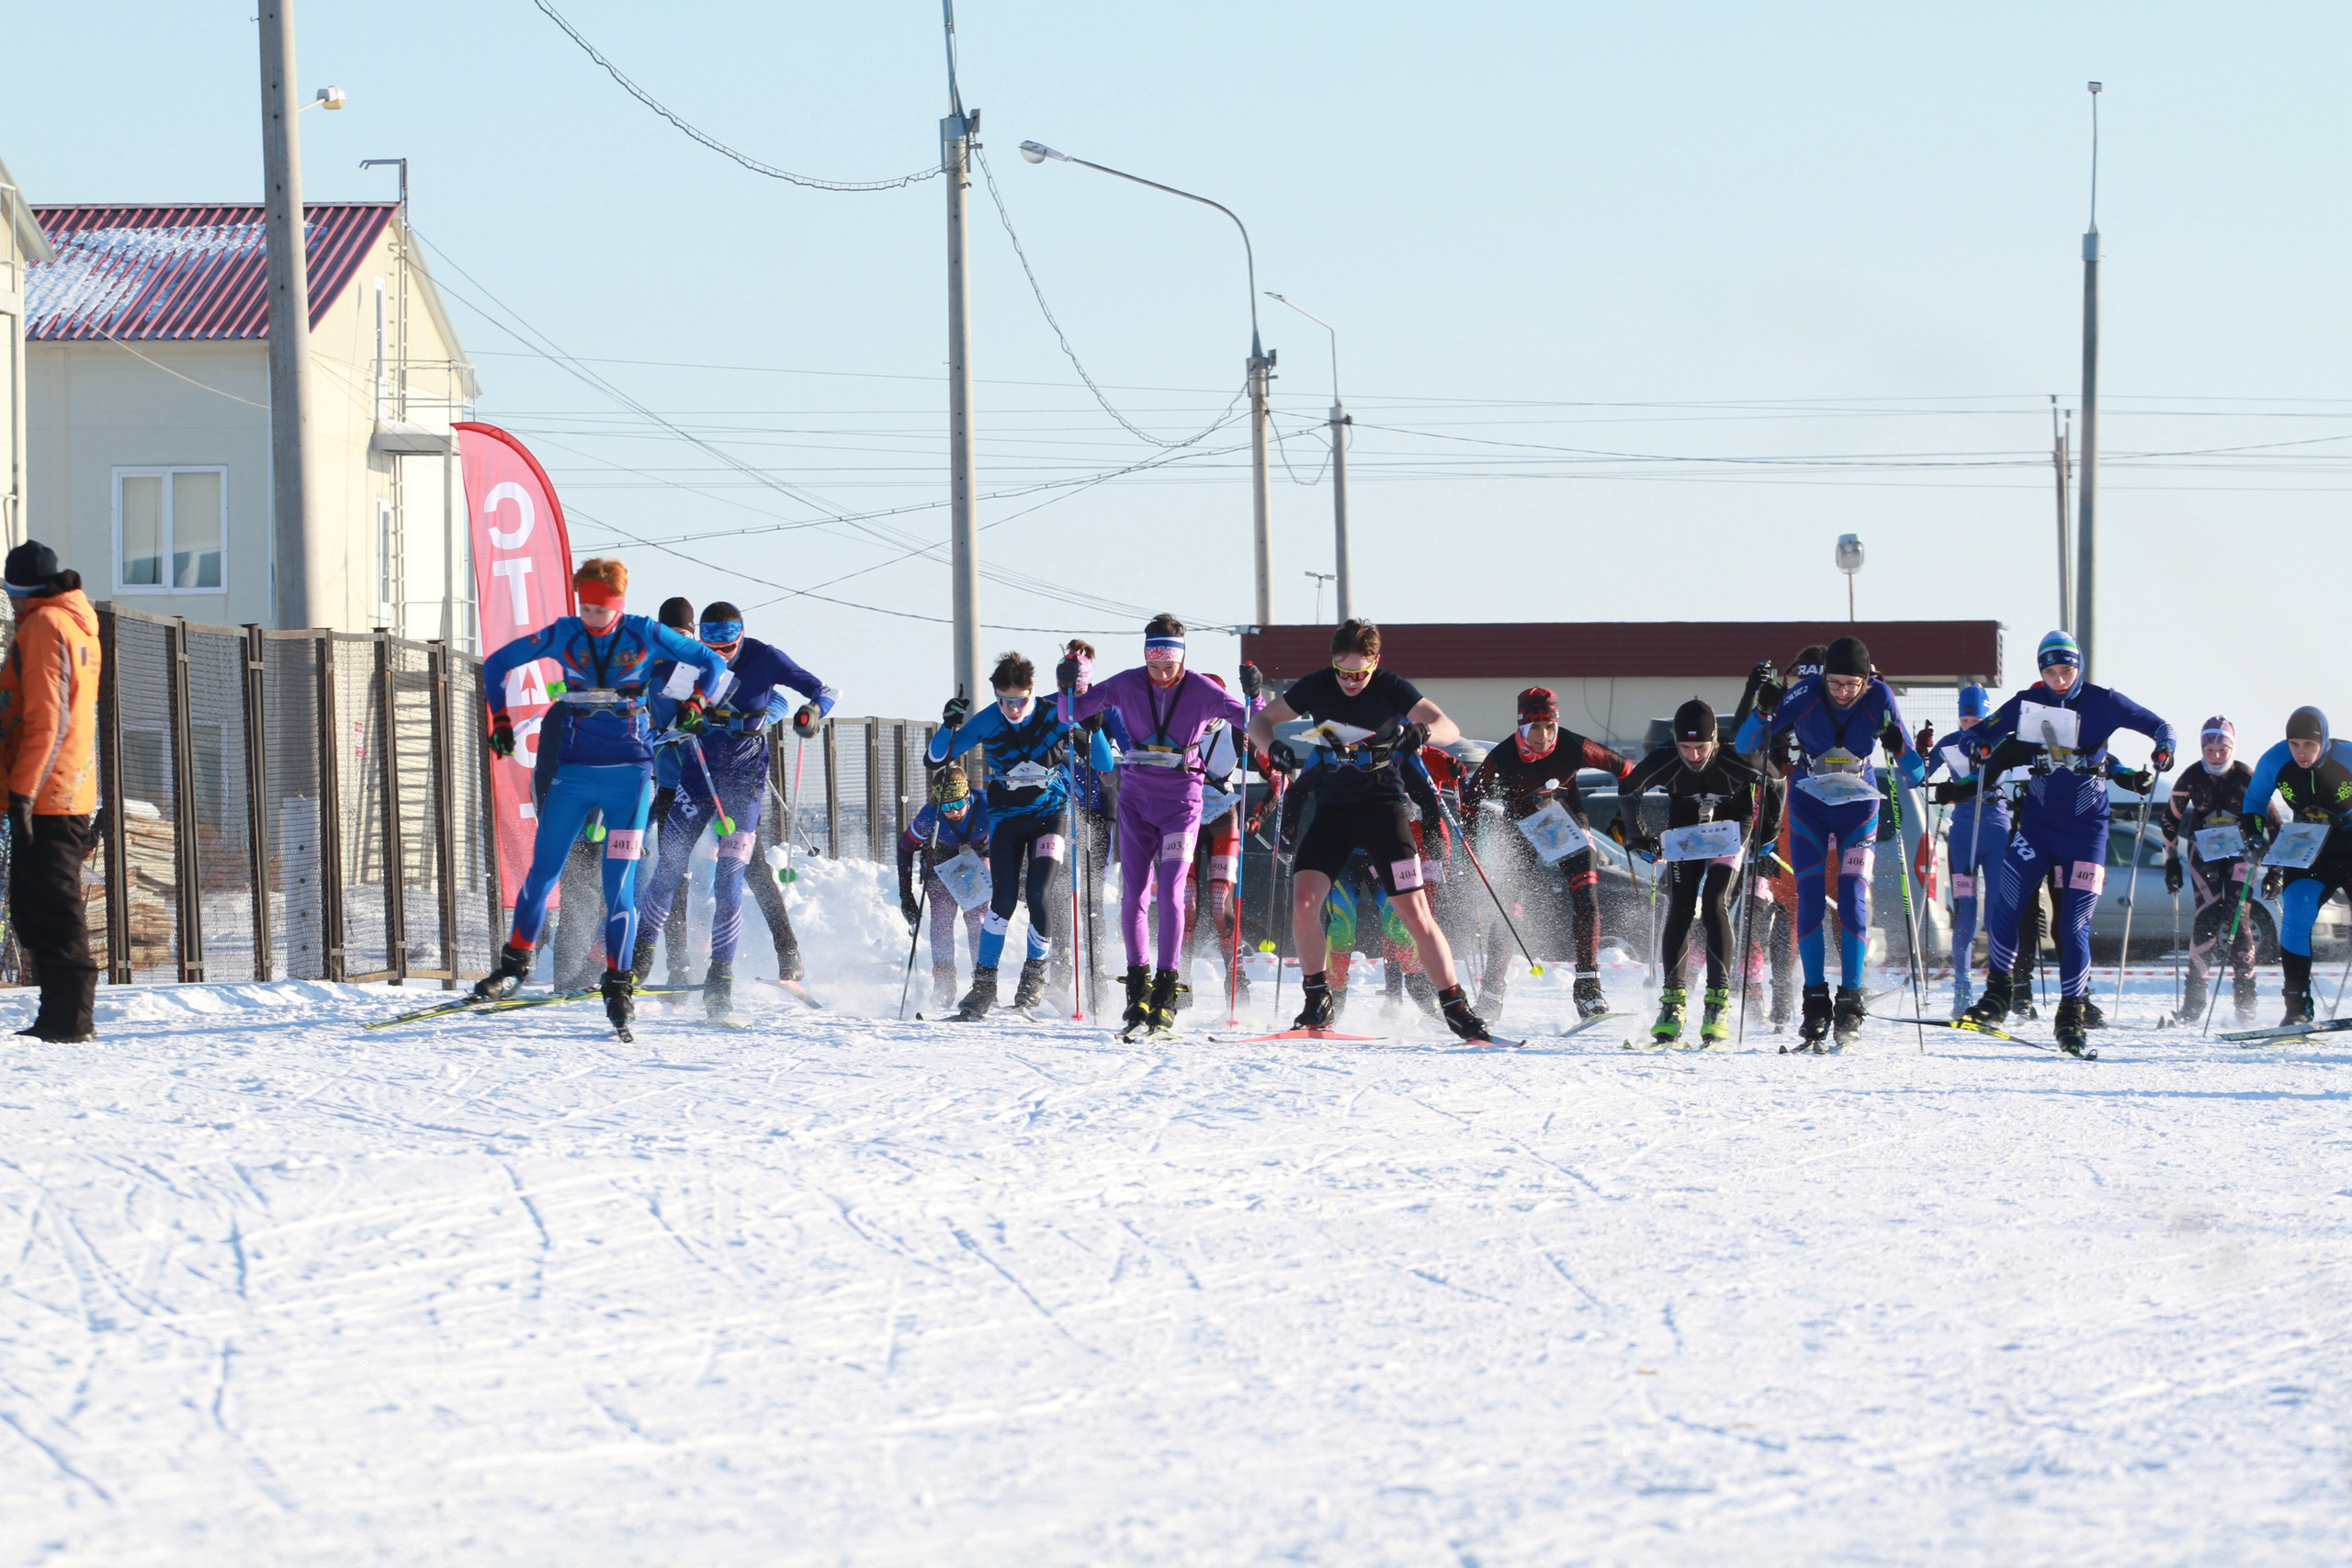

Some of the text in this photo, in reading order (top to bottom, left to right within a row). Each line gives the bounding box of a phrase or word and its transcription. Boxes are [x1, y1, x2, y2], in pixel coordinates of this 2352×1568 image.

[612, 840, 639, 850] 401.1
[1040, 841, 1056, 851] 412
[1847, 856, 1865, 867] 406
